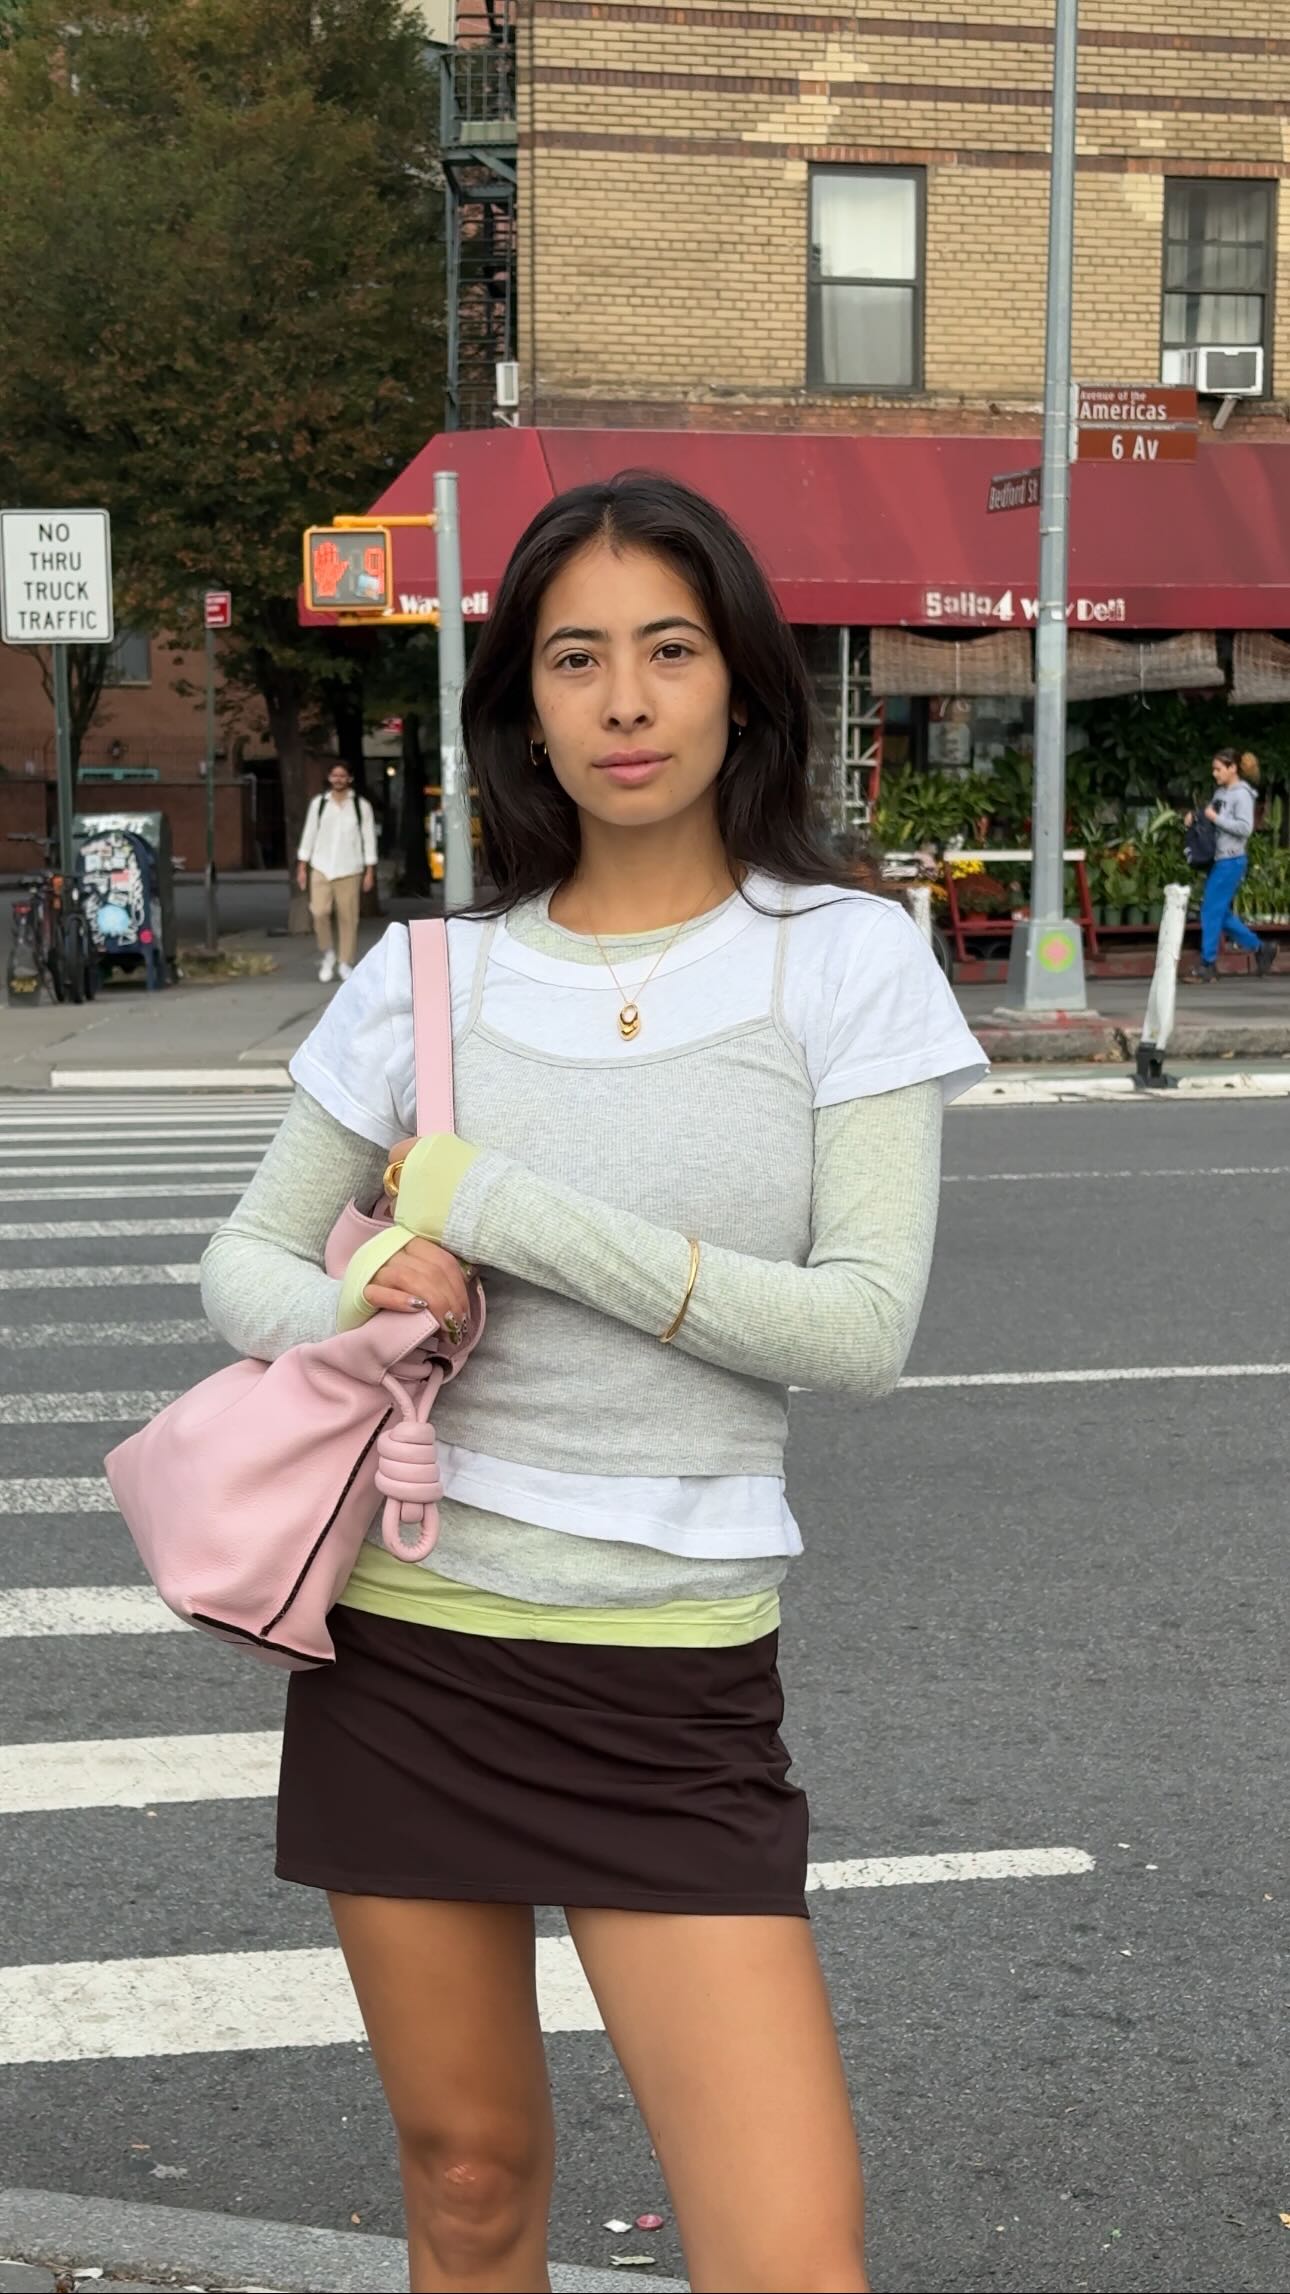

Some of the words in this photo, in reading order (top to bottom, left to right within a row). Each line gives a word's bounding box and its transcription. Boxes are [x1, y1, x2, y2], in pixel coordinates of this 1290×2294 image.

[1081, 390, 1115, 401] Avenue
[1117, 391, 1128, 401] of
[1131, 390, 1147, 401] the
[1080, 400, 1167, 420] Americas
[1111, 434, 1124, 460] 6
[1132, 435, 1160, 460] Av
[988, 478, 1026, 511] Bedford
[1027, 478, 1038, 503] St
[38, 522, 70, 542] NO
[29, 551, 82, 571] THRU
[24, 580, 89, 601] TRUCK
[461, 591, 489, 614] eli
[1077, 598, 1126, 622] Deli
[18, 610, 97, 631] TRAFFIC
